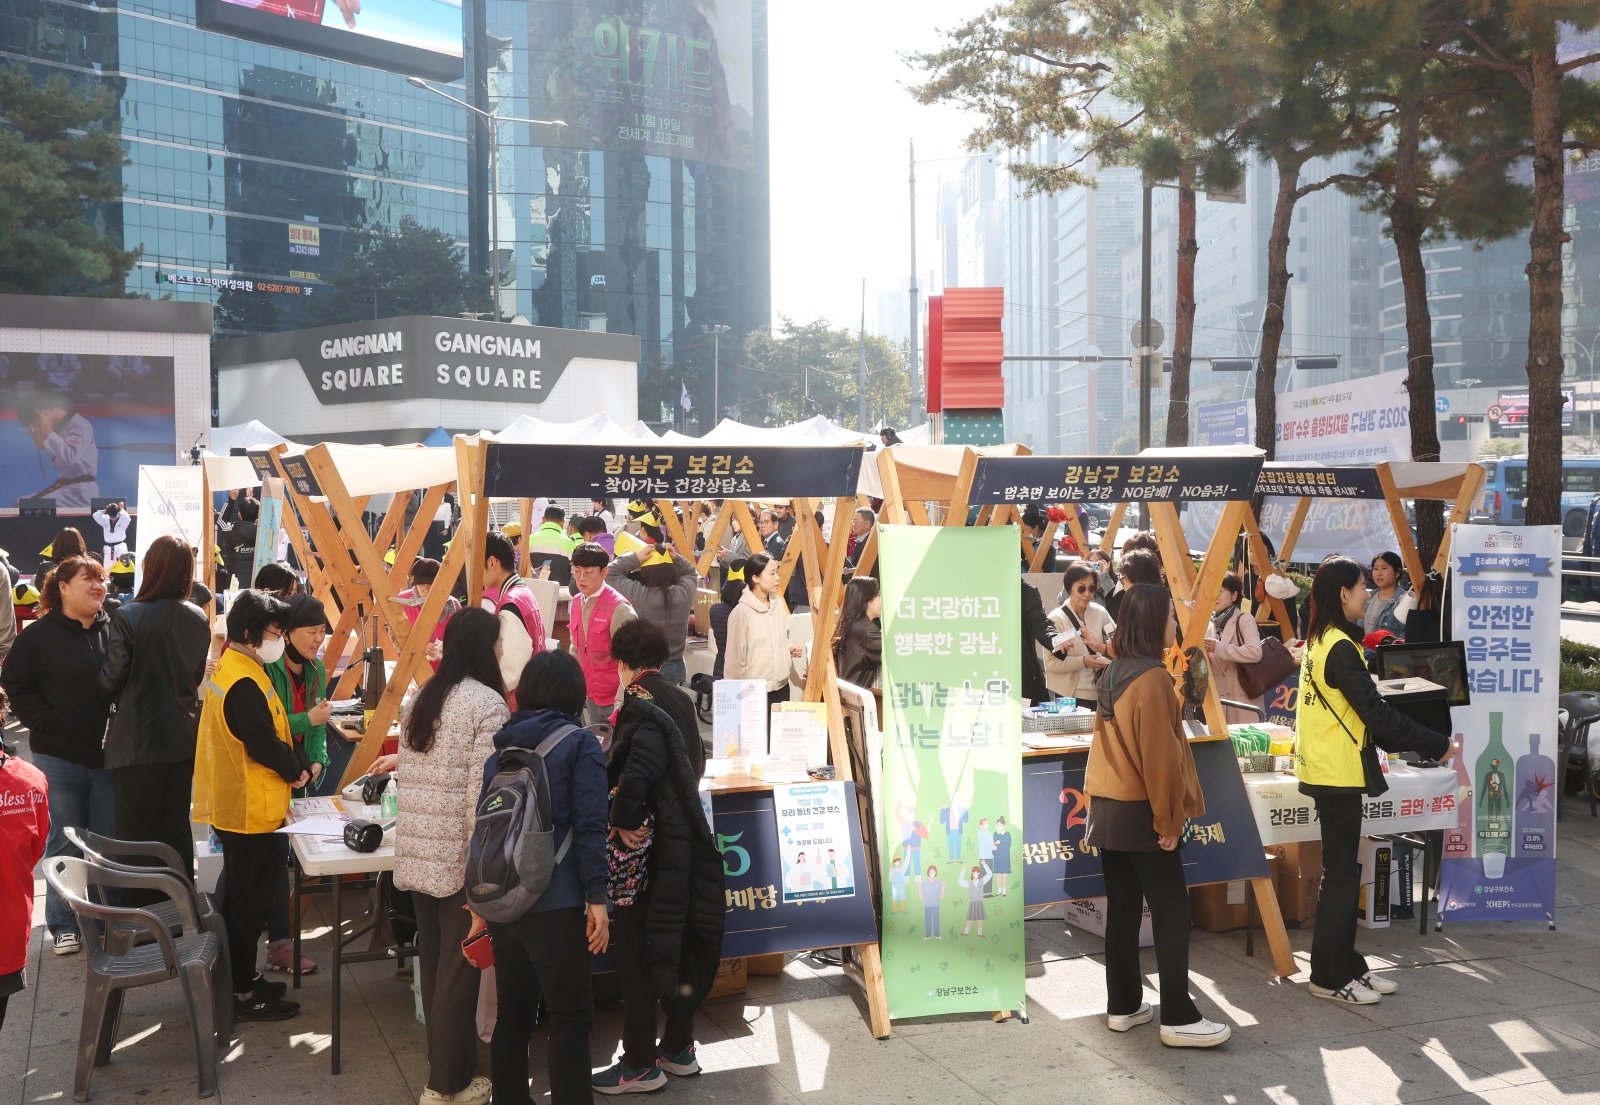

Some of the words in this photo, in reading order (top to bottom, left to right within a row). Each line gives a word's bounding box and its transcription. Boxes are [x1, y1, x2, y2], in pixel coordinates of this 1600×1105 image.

[593, 15, 713, 98] 위키드
[670, 100, 713, 117] GOOD
[634, 113, 656, 128] 11월
[658, 117, 681, 132] 19일
[618, 126, 651, 142] 전세계
[654, 130, 695, 149] 최초개봉
[167, 272, 254, 292] 베스트오브미여성의원
[303, 286, 313, 297] 3F
[320, 331, 402, 360] GANGNAM
[434, 331, 542, 359] GANGNAM
[321, 363, 403, 391] SQUARE
[436, 363, 542, 389] SQUARE
[604, 454, 674, 475] 강남구
[687, 454, 755, 475] 보건소
[1064, 465, 1120, 484] 강남구
[1129, 464, 1181, 483] 보건소
[604, 477, 670, 494] 찾아가는
[673, 477, 753, 493] 건강상담소
[1004, 485, 1043, 501] 멈추면
[1044, 485, 1085, 500] 보이는
[1086, 485, 1114, 500] 건강
[1121, 484, 1172, 499] NO담배!
[1180, 484, 1229, 498] NO음주!
[1470, 585, 1489, 594] 언제나
[897, 597, 916, 620] 더
[921, 596, 1001, 620] 건강하고
[1467, 605, 1535, 630] 안전한
[893, 631, 954, 656] 행복한
[959, 631, 1003, 655] 강남,
[1466, 636, 1532, 662] 음주는
[891, 681, 957, 709] 담배는
[963, 679, 1012, 709] 노담
[895, 723, 941, 750] 나는
[781, 809, 796, 818] 우리
[796, 807, 811, 816] 동네
[812, 806, 826, 815] 건강
[827, 805, 841, 814] 부스
[1269, 807, 1310, 827] 건강을
[1378, 853, 1388, 863] 19
[935, 985, 979, 998] 강남구보건소
